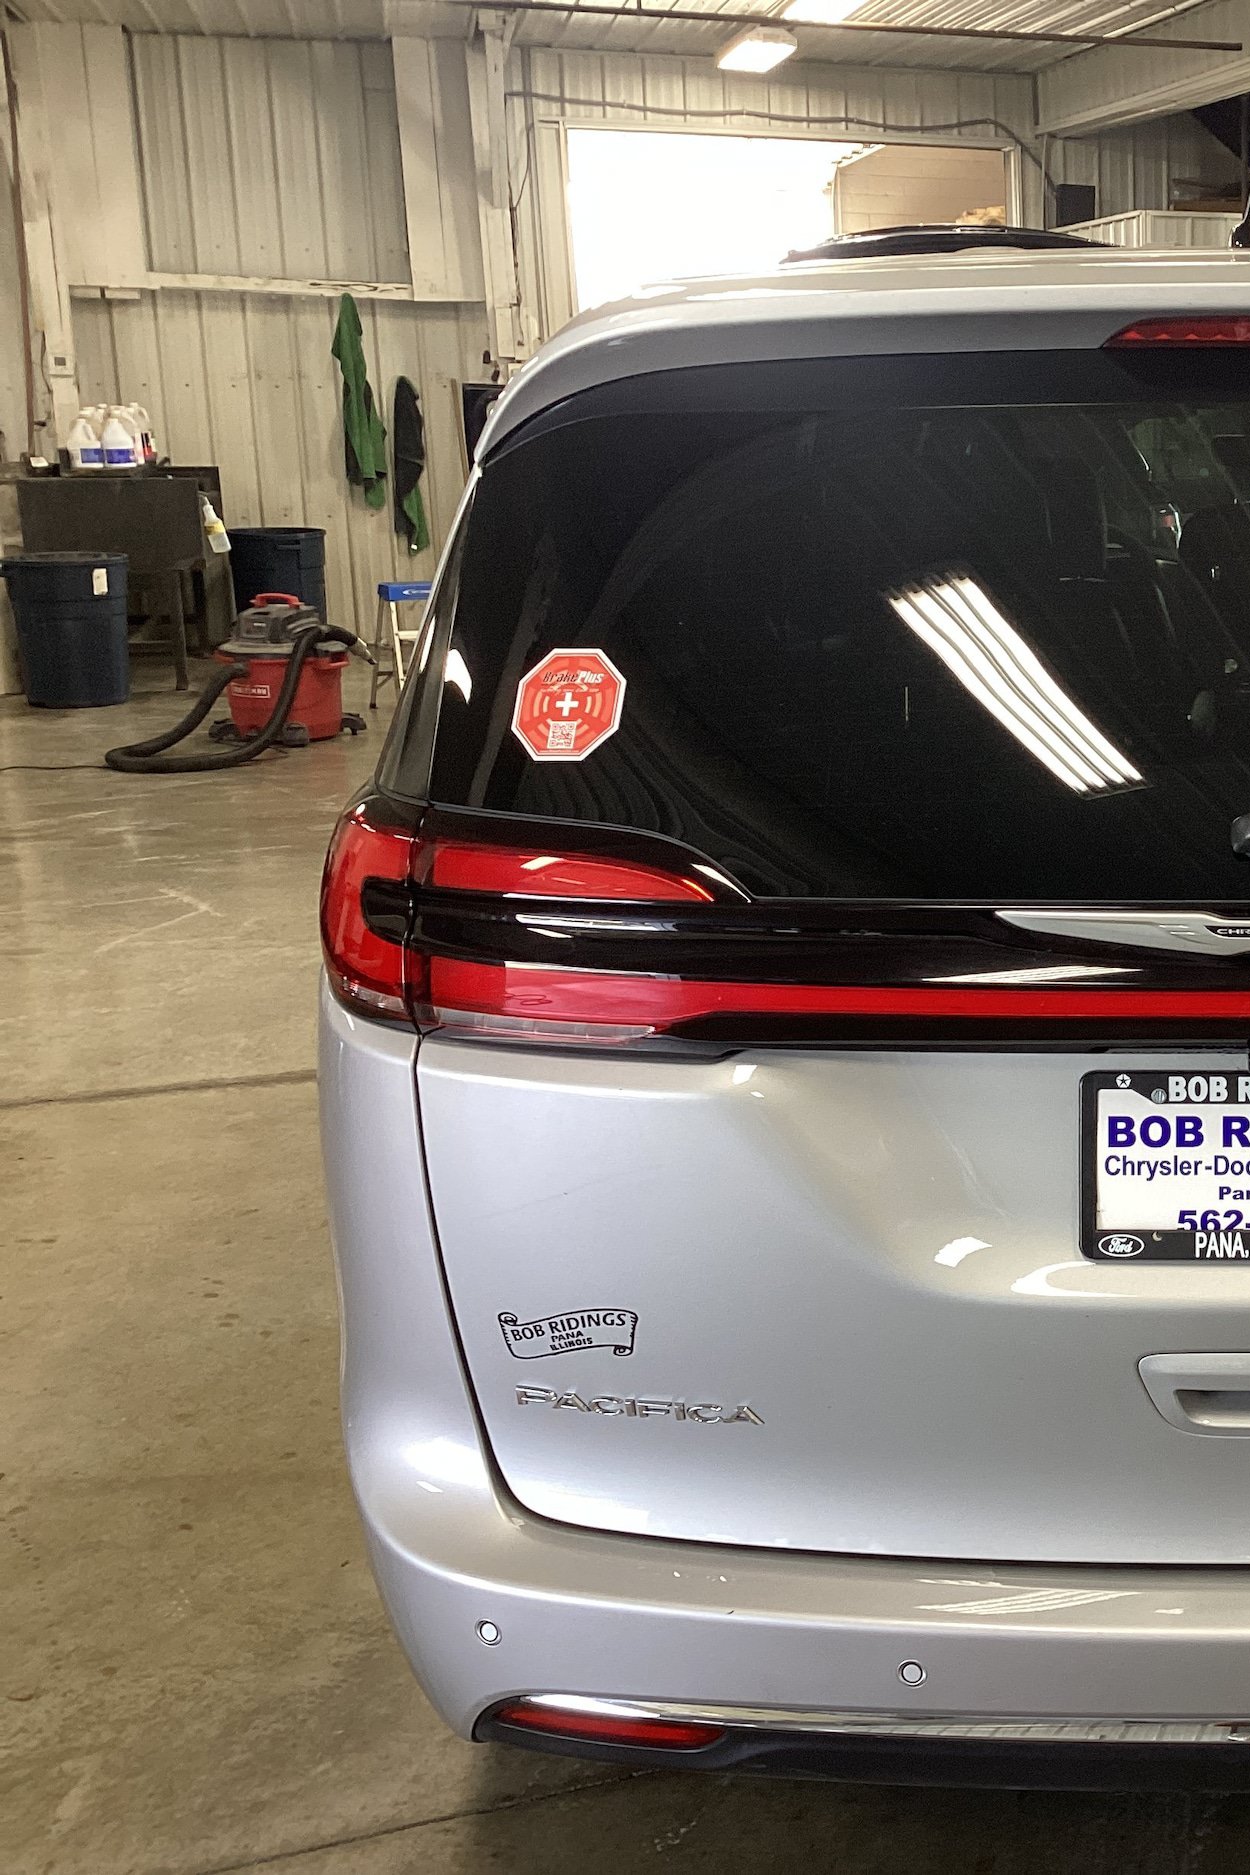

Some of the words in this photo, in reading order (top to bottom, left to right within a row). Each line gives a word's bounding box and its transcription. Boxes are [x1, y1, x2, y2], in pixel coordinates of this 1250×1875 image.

[1167, 1075, 1229, 1103] BOB
[1106, 1115, 1205, 1148] BOB
[1108, 1237, 1134, 1254] Ford
[1195, 1231, 1250, 1258] PANA,
[511, 1324, 546, 1342] BOB
[548, 1312, 627, 1334] RIDINGS
[551, 1330, 585, 1343] PANA
[550, 1337, 594, 1351] ILLINOIS
[515, 1384, 766, 1425] PACIFICA
